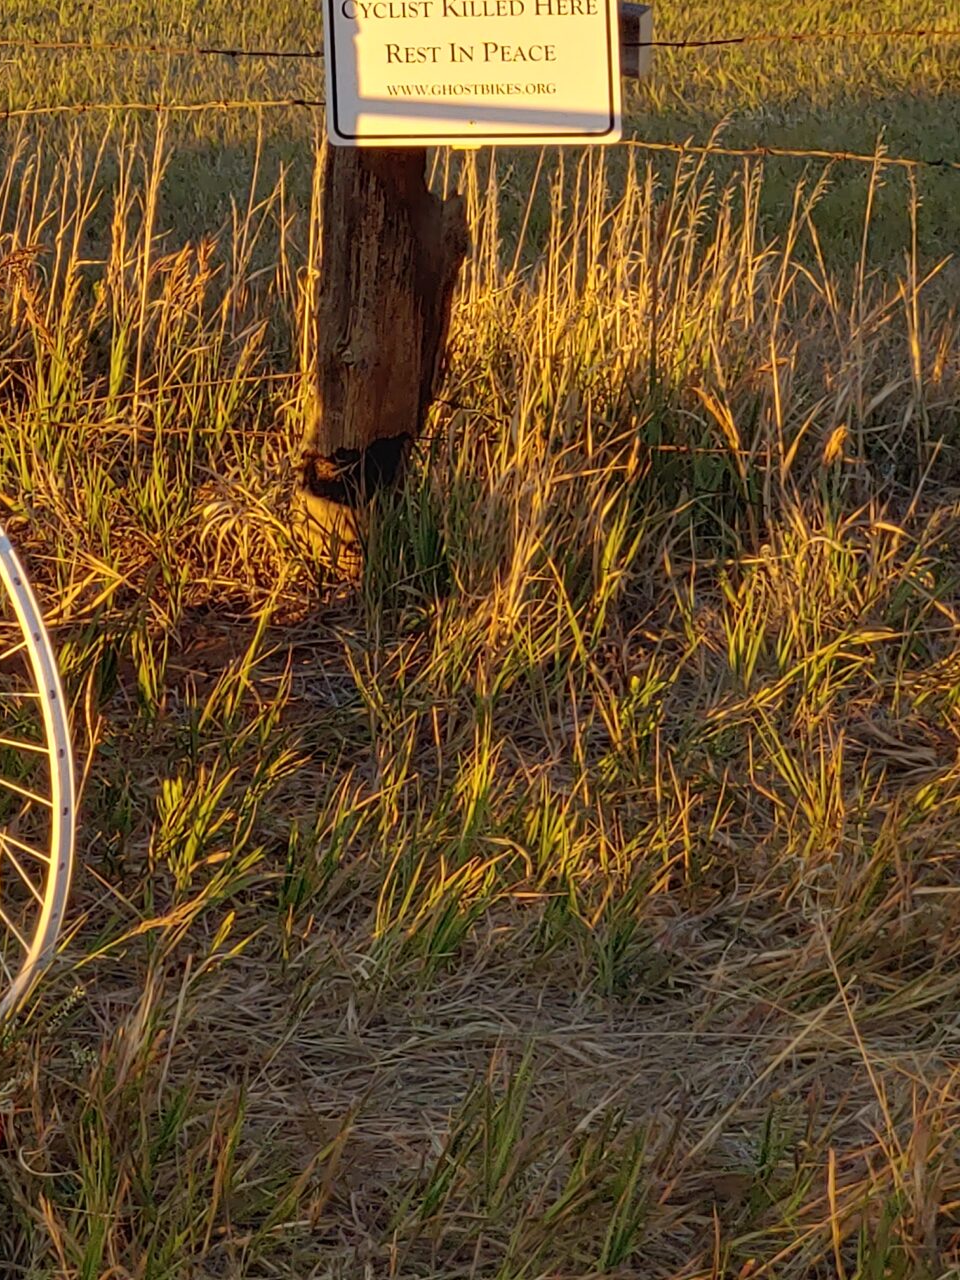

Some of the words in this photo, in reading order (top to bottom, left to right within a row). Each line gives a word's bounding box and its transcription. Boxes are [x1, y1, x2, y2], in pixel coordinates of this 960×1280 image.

[385, 43, 441, 64] REST
[448, 42, 475, 63] IN
[482, 41, 557, 63] PEACE
[387, 82, 557, 97] WWW.GHOSTBIKES.ORG
